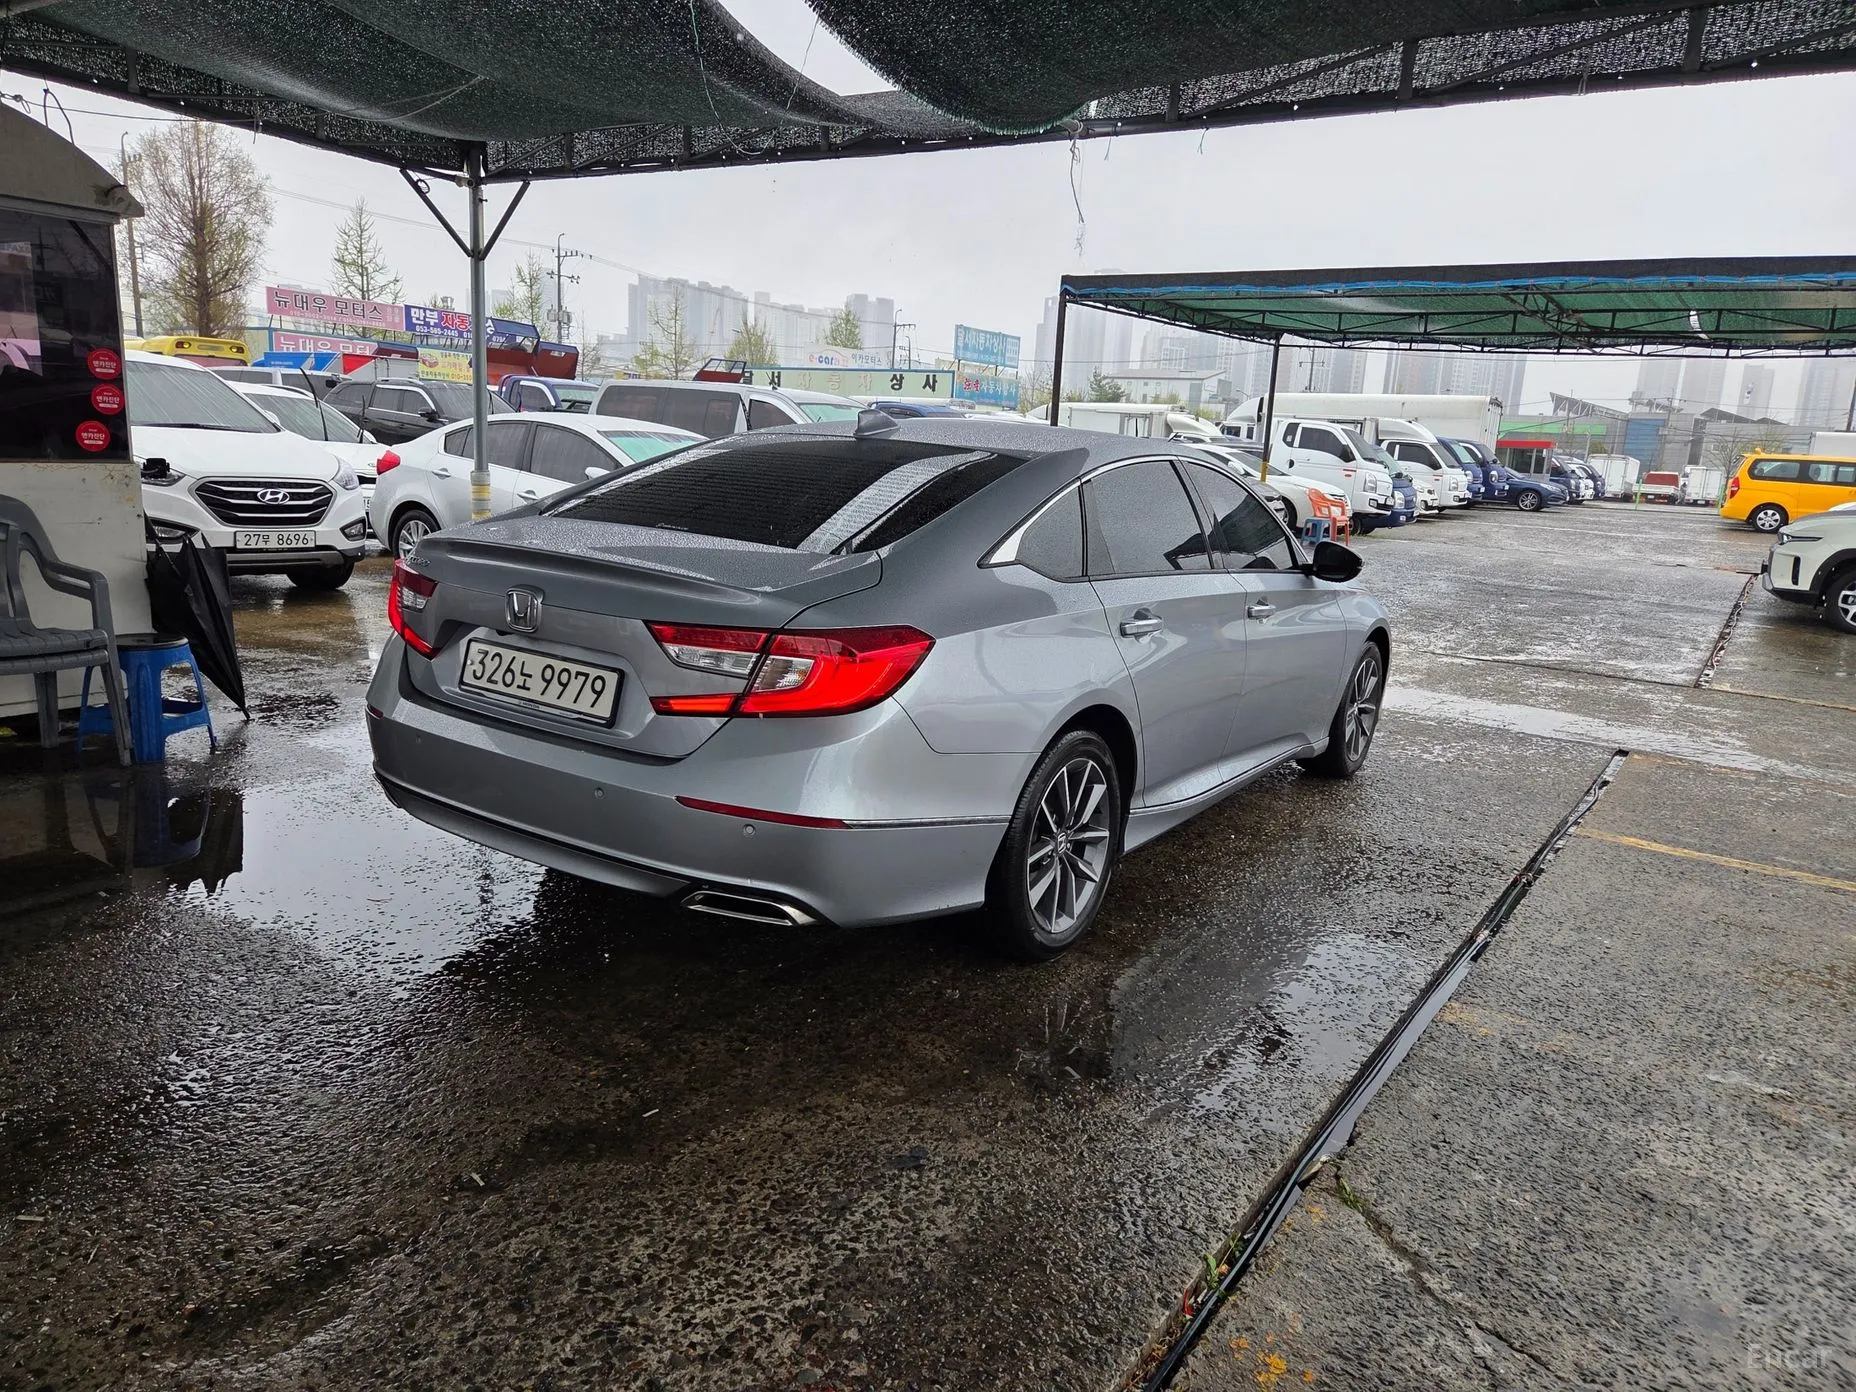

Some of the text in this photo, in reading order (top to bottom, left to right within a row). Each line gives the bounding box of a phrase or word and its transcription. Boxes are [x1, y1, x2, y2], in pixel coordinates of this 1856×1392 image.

[274, 291, 328, 313] 뉴대우
[334, 299, 383, 320] 모터스
[411, 307, 439, 325] 만부
[244, 533, 309, 546] 27무 8696
[472, 649, 606, 708] 326노 9979
